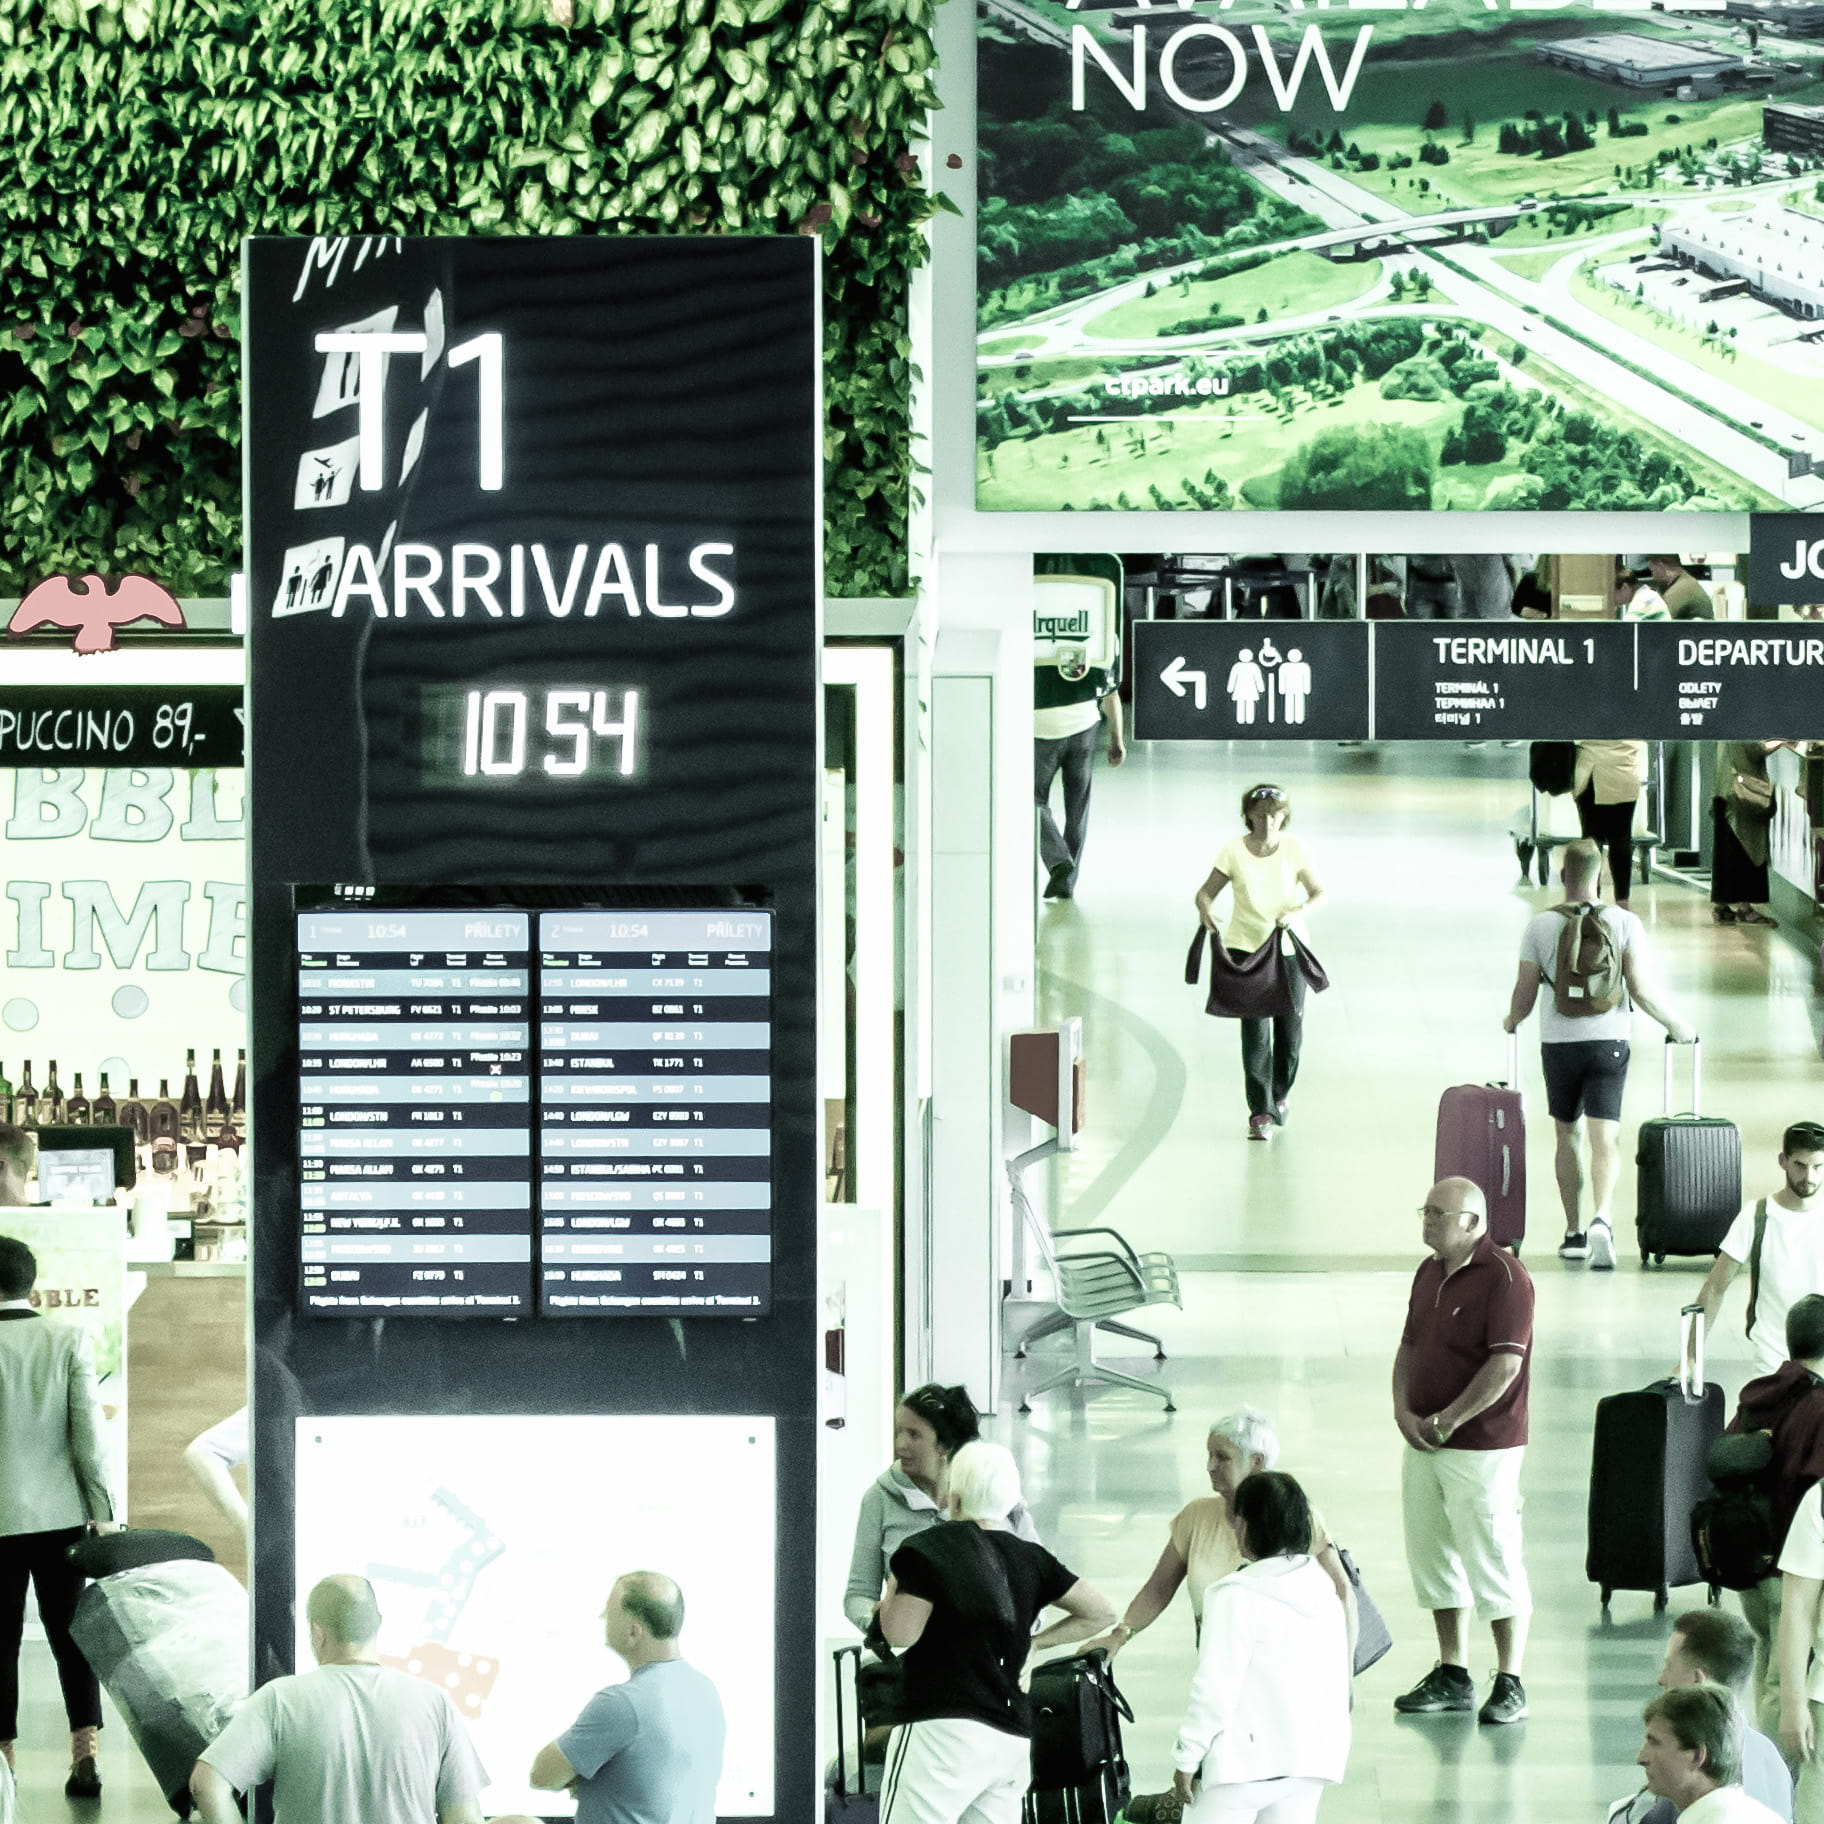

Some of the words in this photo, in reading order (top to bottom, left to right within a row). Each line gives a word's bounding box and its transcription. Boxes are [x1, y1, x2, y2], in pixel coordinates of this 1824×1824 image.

[1071, 24, 1374, 113] NOW
[1104, 373, 1229, 400] ctpark.eu
[315, 333, 503, 490] T1
[331, 543, 735, 618] ARRIVALS
[1433, 637, 1574, 665] TERMINAL
[1583, 638, 1594, 665] 1
[1435, 680, 1490, 694] TERMINÁL
[1493, 683, 1499, 694] 1
[1679, 682, 1723, 694] ODLETY
[152, 702, 206, 757] 89,-
[367, 924, 407, 938] 10:54
[465, 921, 520, 938] PŘÍLETY
[609, 924, 649, 938] 10:54
[707, 921, 762, 938] PŘÍLETY
[329, 1005, 343, 1015] ST
[452, 1005, 461, 1014] T1
[693, 1005, 702, 1013] T1
[452, 1058, 461, 1067] T1
[694, 1058, 703, 1067] T1
[453, 1111, 462, 1120] T1
